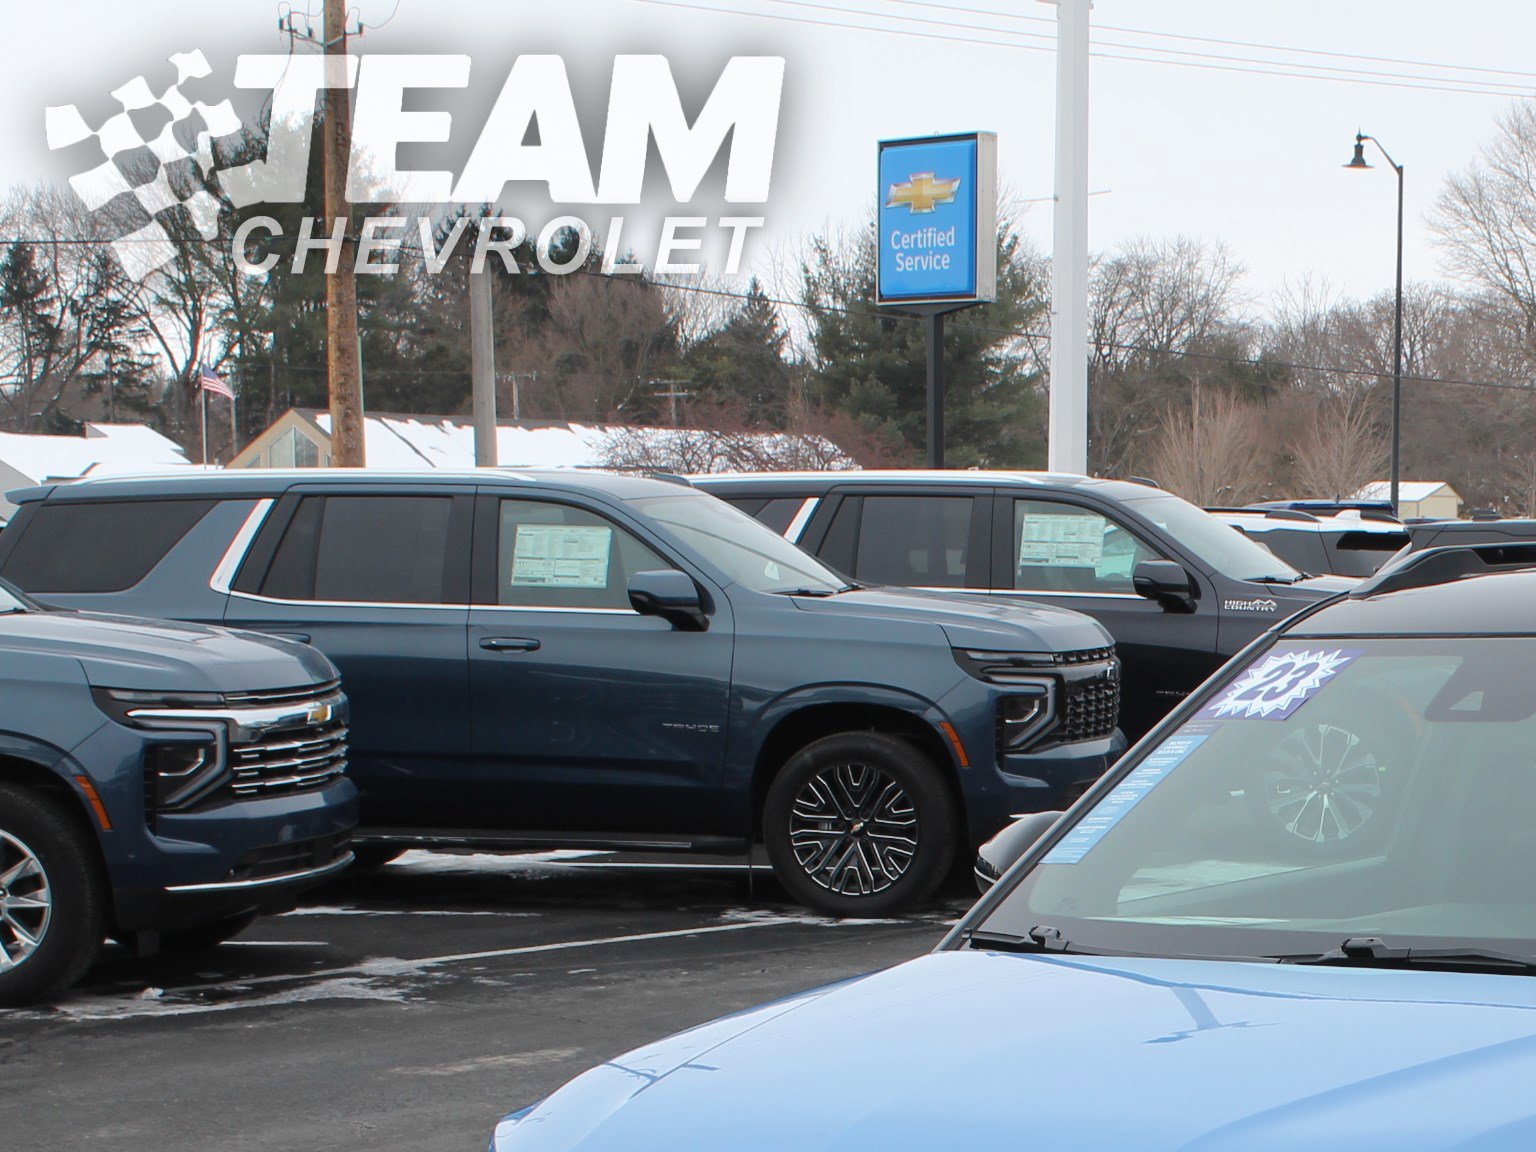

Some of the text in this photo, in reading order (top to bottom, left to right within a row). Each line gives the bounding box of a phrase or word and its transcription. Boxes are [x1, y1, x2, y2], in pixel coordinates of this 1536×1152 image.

[890, 226, 955, 250] Certified
[895, 250, 950, 272] Service
[1224, 604, 1277, 612] COUNTRY
[1232, 661, 1321, 703] 23
